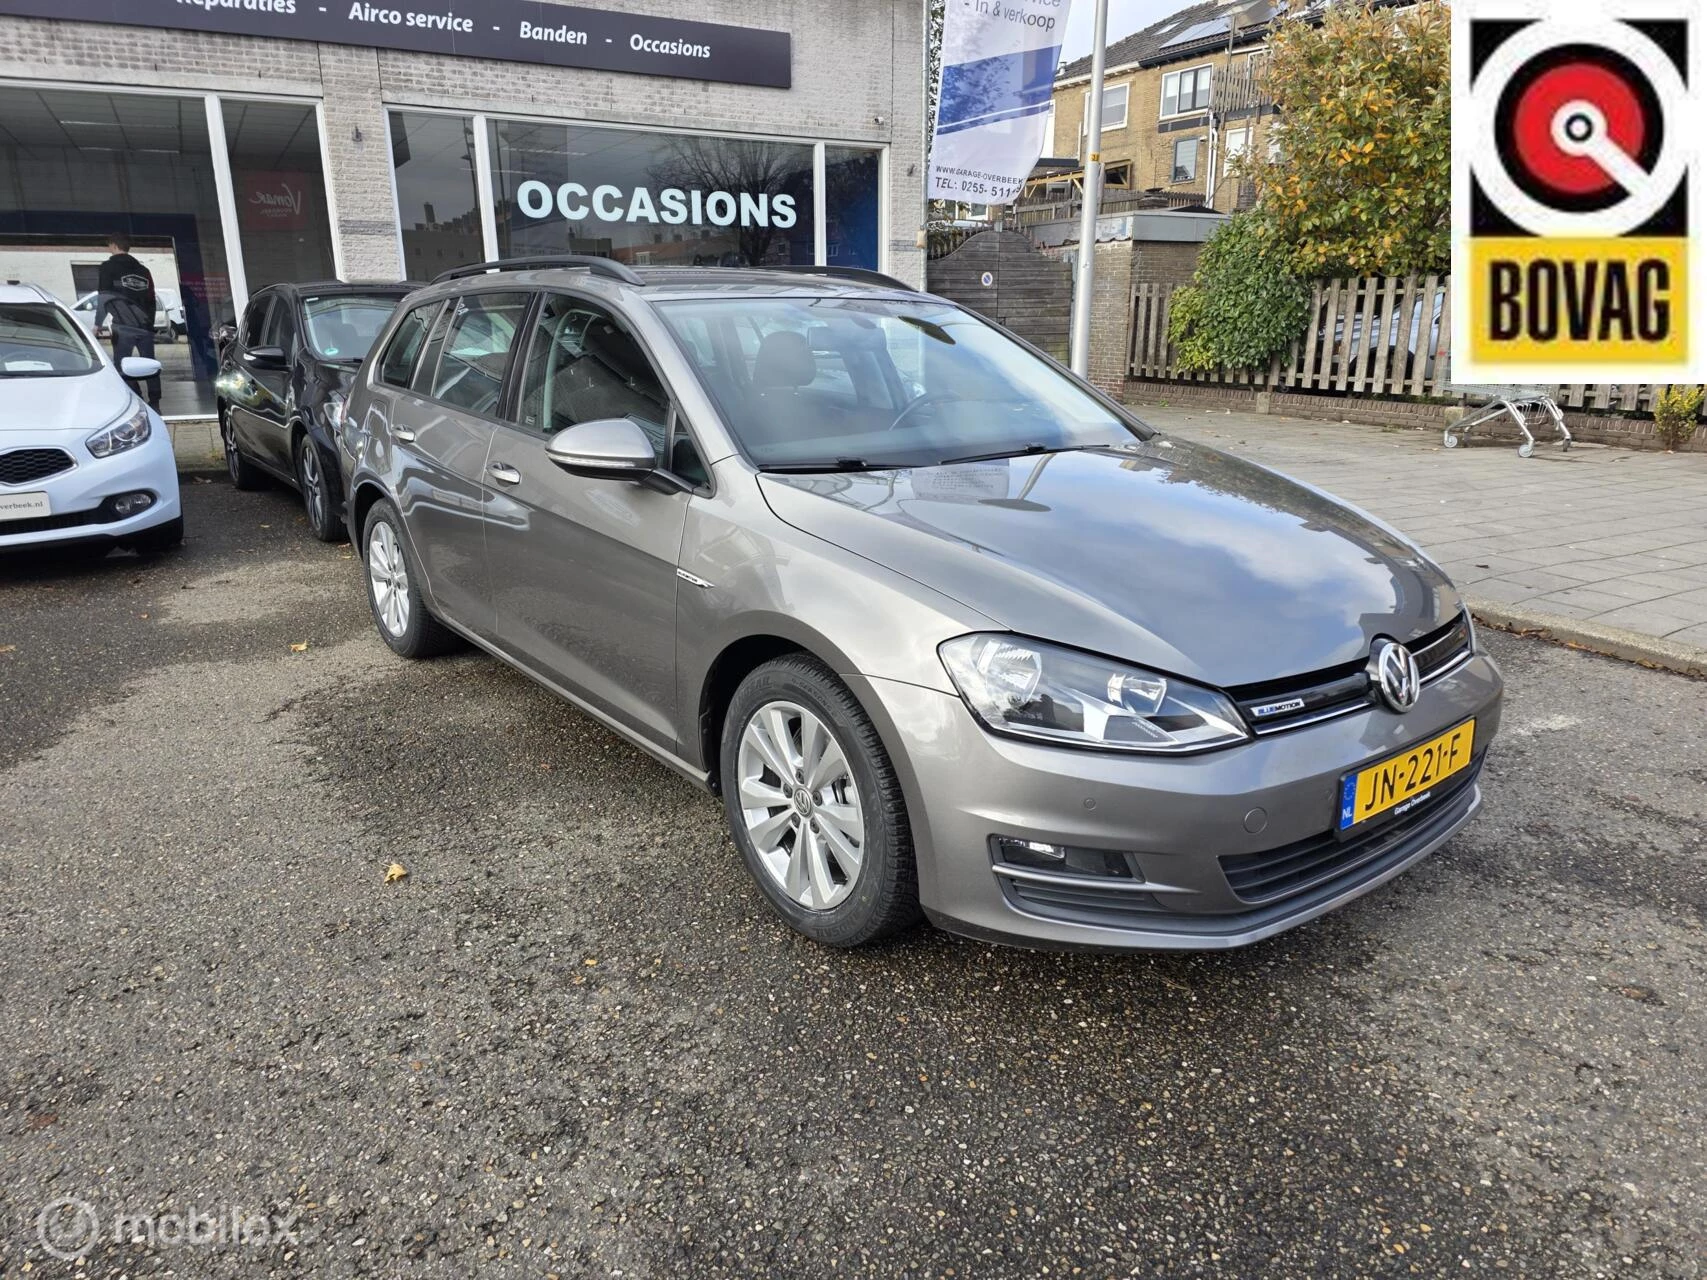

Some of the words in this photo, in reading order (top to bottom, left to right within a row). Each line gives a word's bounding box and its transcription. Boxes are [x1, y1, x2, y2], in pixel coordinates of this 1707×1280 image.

[177, 0, 296, 13] paraties
[348, 2, 401, 25] Airco
[406, 12, 473, 32] service
[519, 21, 588, 45] Banden
[630, 34, 711, 58] Occasions
[993, 0, 1001, 17] &
[1003, 7, 1056, 32] verkoop
[517, 180, 797, 229] OCCASIONS
[936, 177, 958, 190] TEL:
[961, 180, 987, 194] 0255-
[1364, 732, 1461, 812] JN-221-F
[1342, 806, 1353, 820] NL
